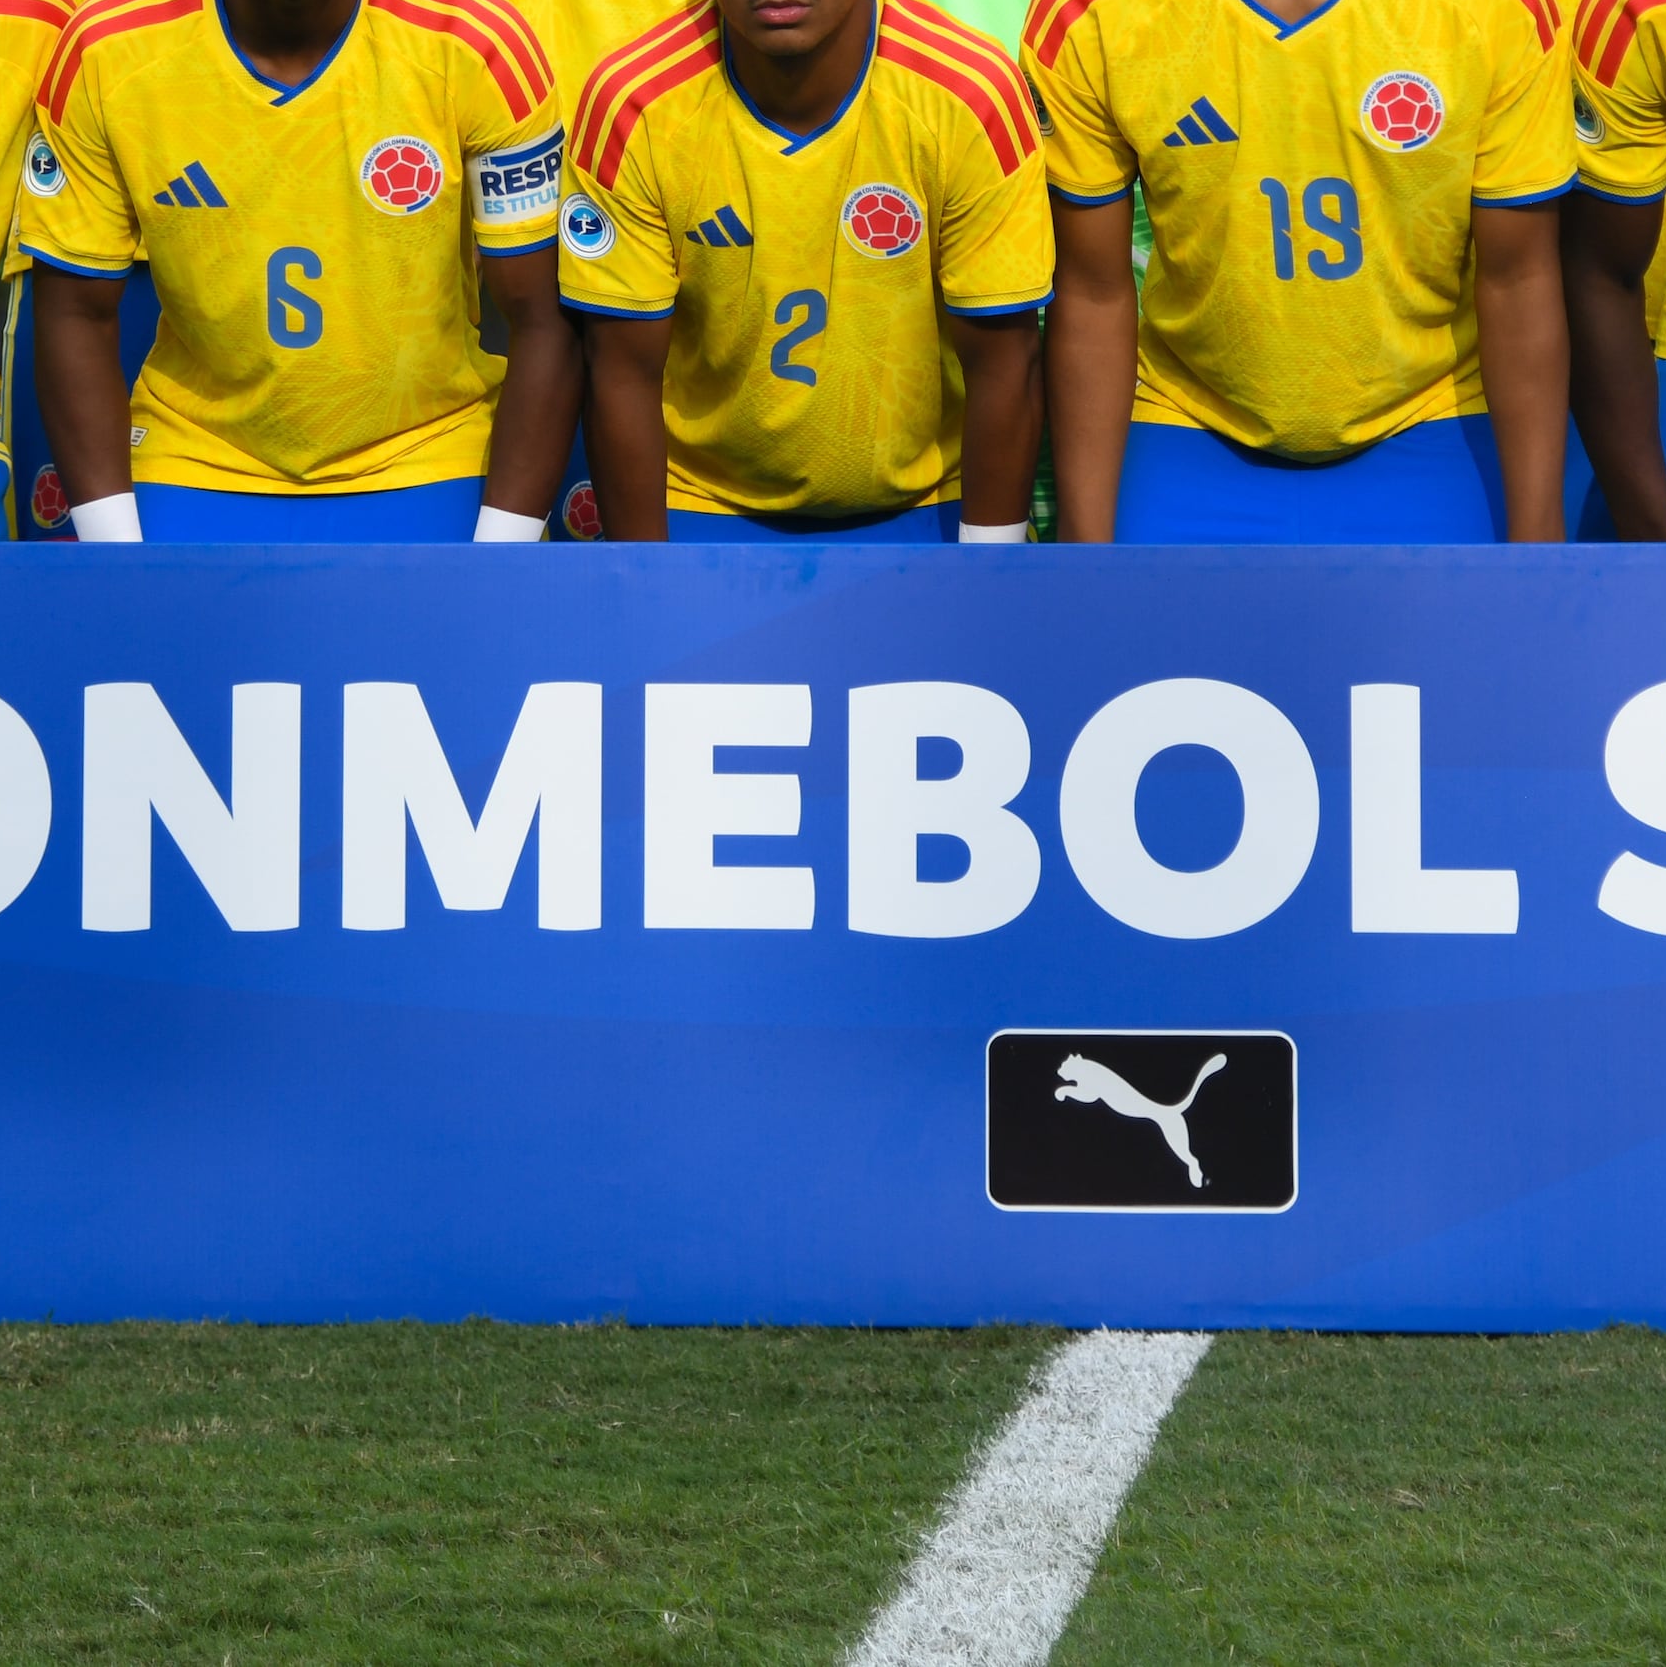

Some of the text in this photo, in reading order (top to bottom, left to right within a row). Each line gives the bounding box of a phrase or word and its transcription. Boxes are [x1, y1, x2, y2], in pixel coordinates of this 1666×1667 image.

[480, 147, 564, 197] RESP
[483, 200, 506, 215] ES
[1259, 177, 1365, 281] 19
[267, 246, 324, 349] 6
[770, 289, 828, 387] 2
